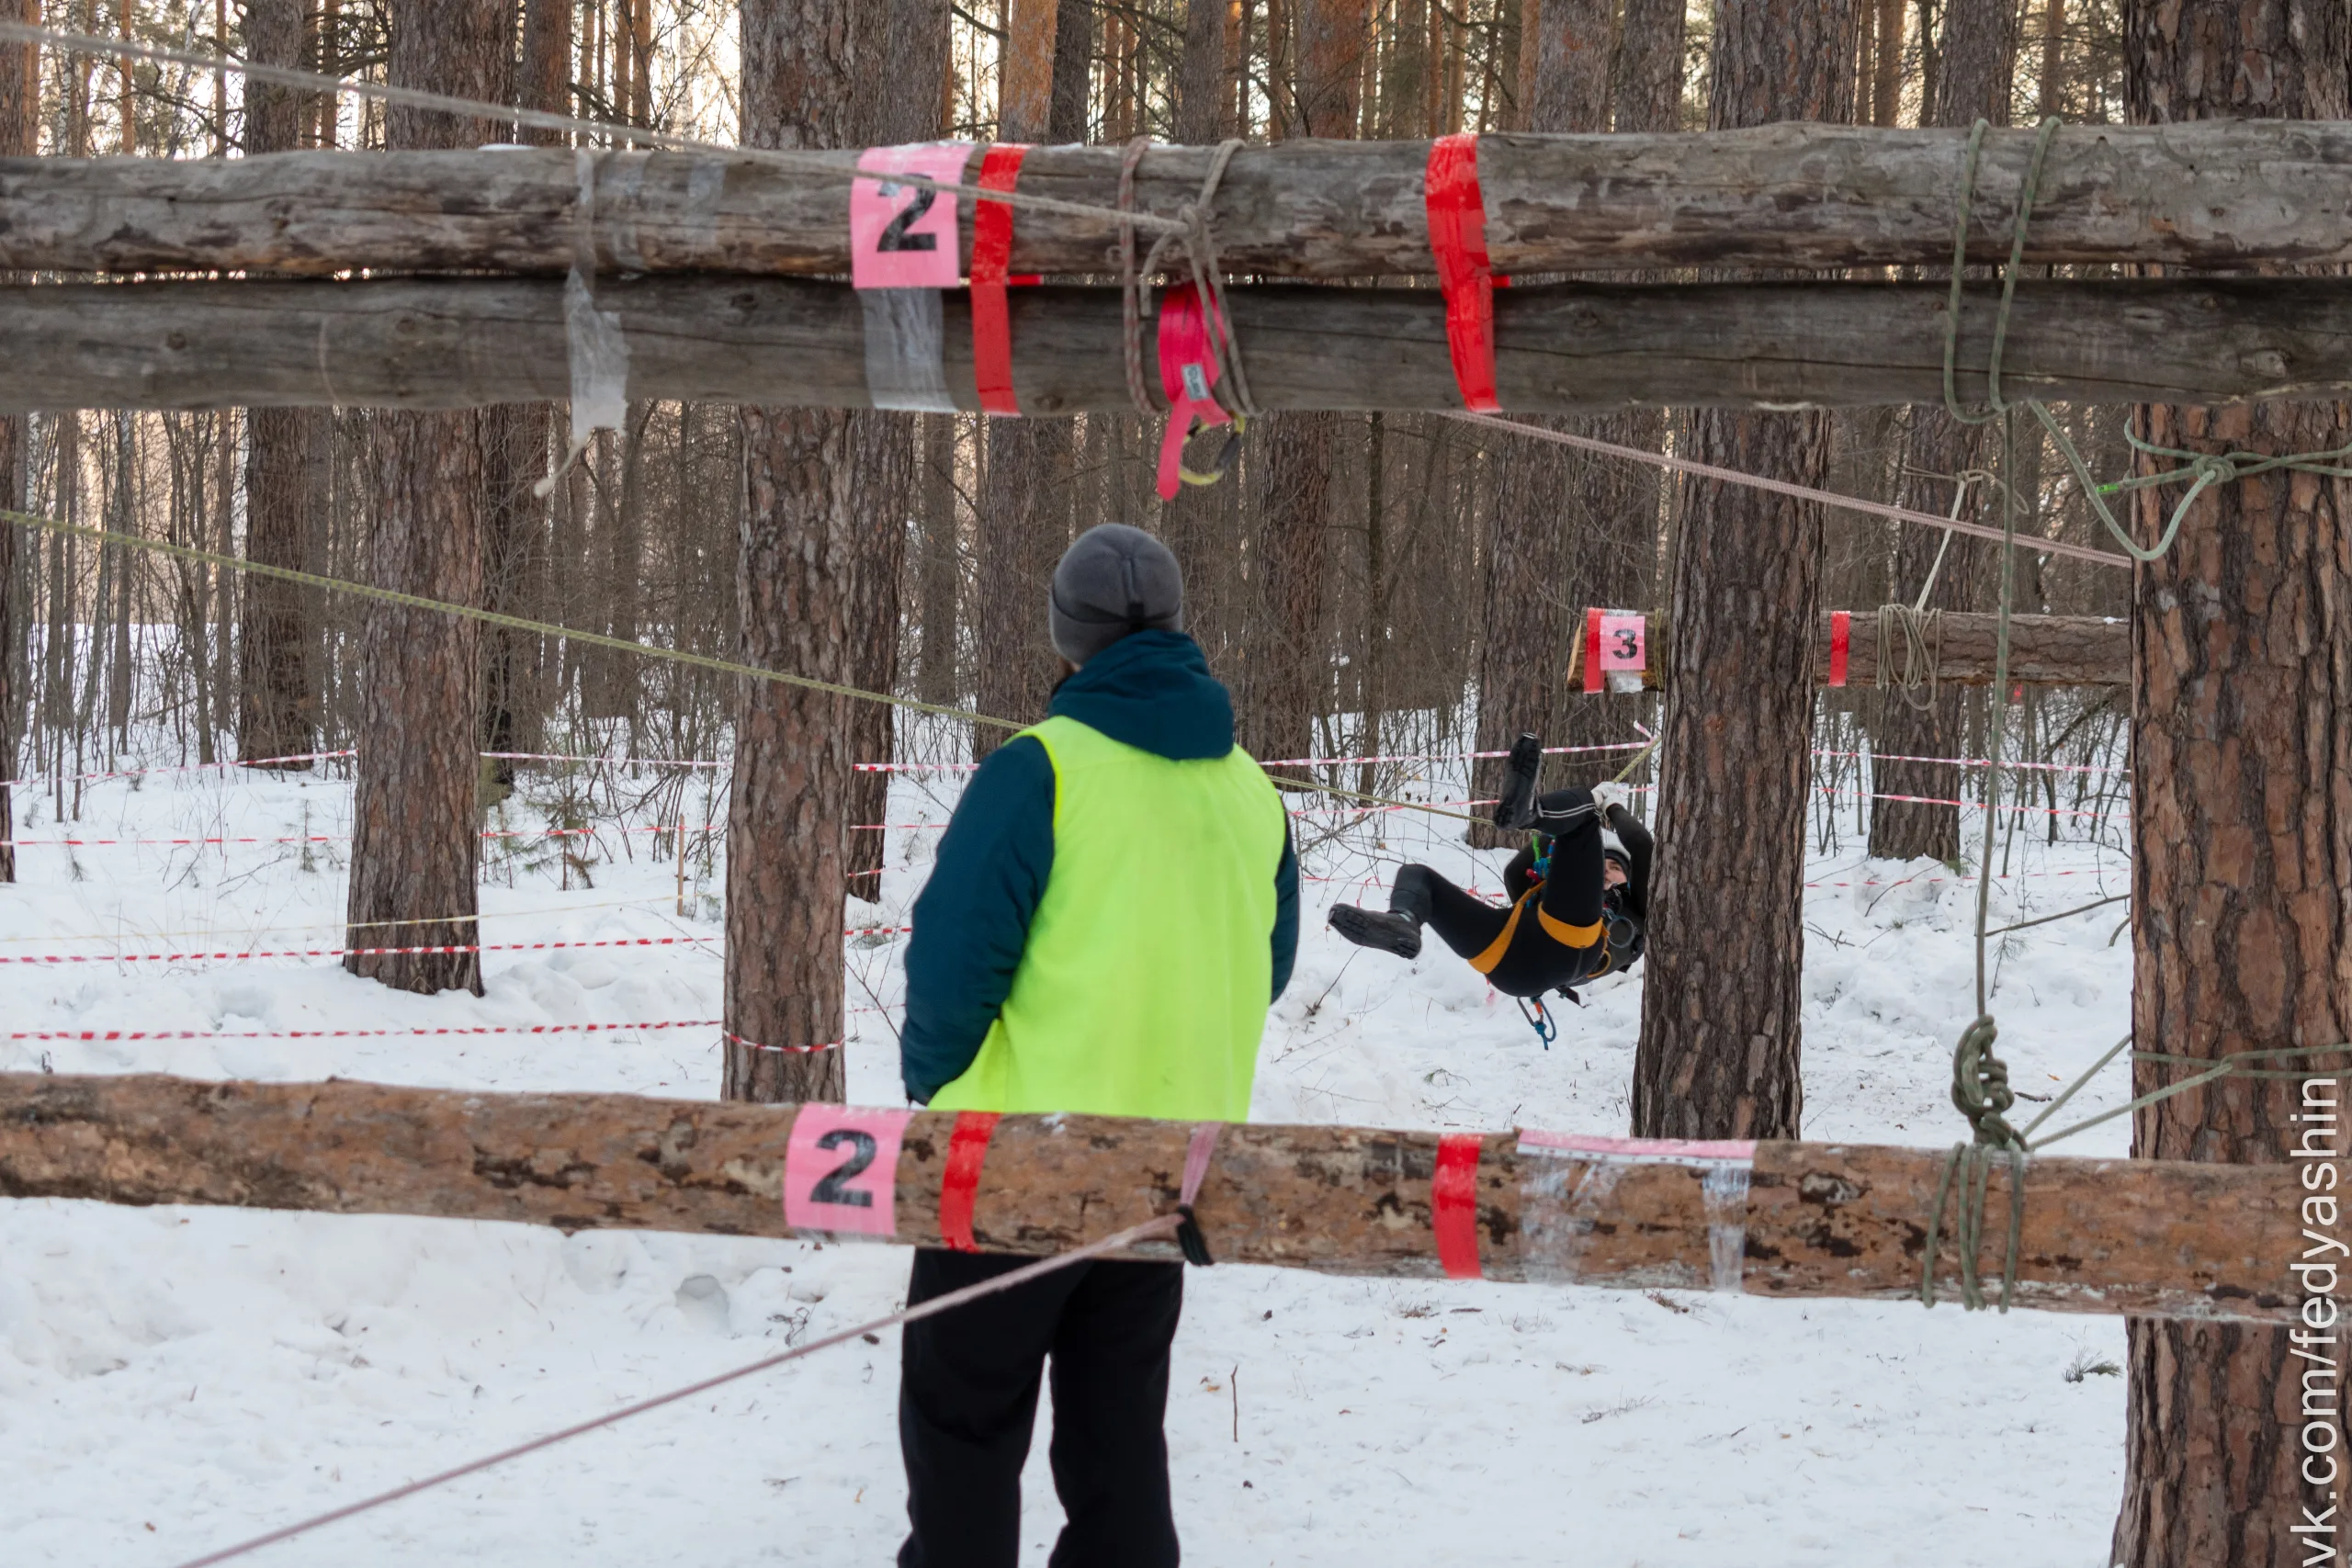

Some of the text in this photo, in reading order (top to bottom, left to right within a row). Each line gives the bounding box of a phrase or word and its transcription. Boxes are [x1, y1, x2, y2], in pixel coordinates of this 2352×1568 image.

[877, 173, 937, 253] 2
[1612, 629, 1638, 660] 3
[809, 1129, 876, 1208] 2
